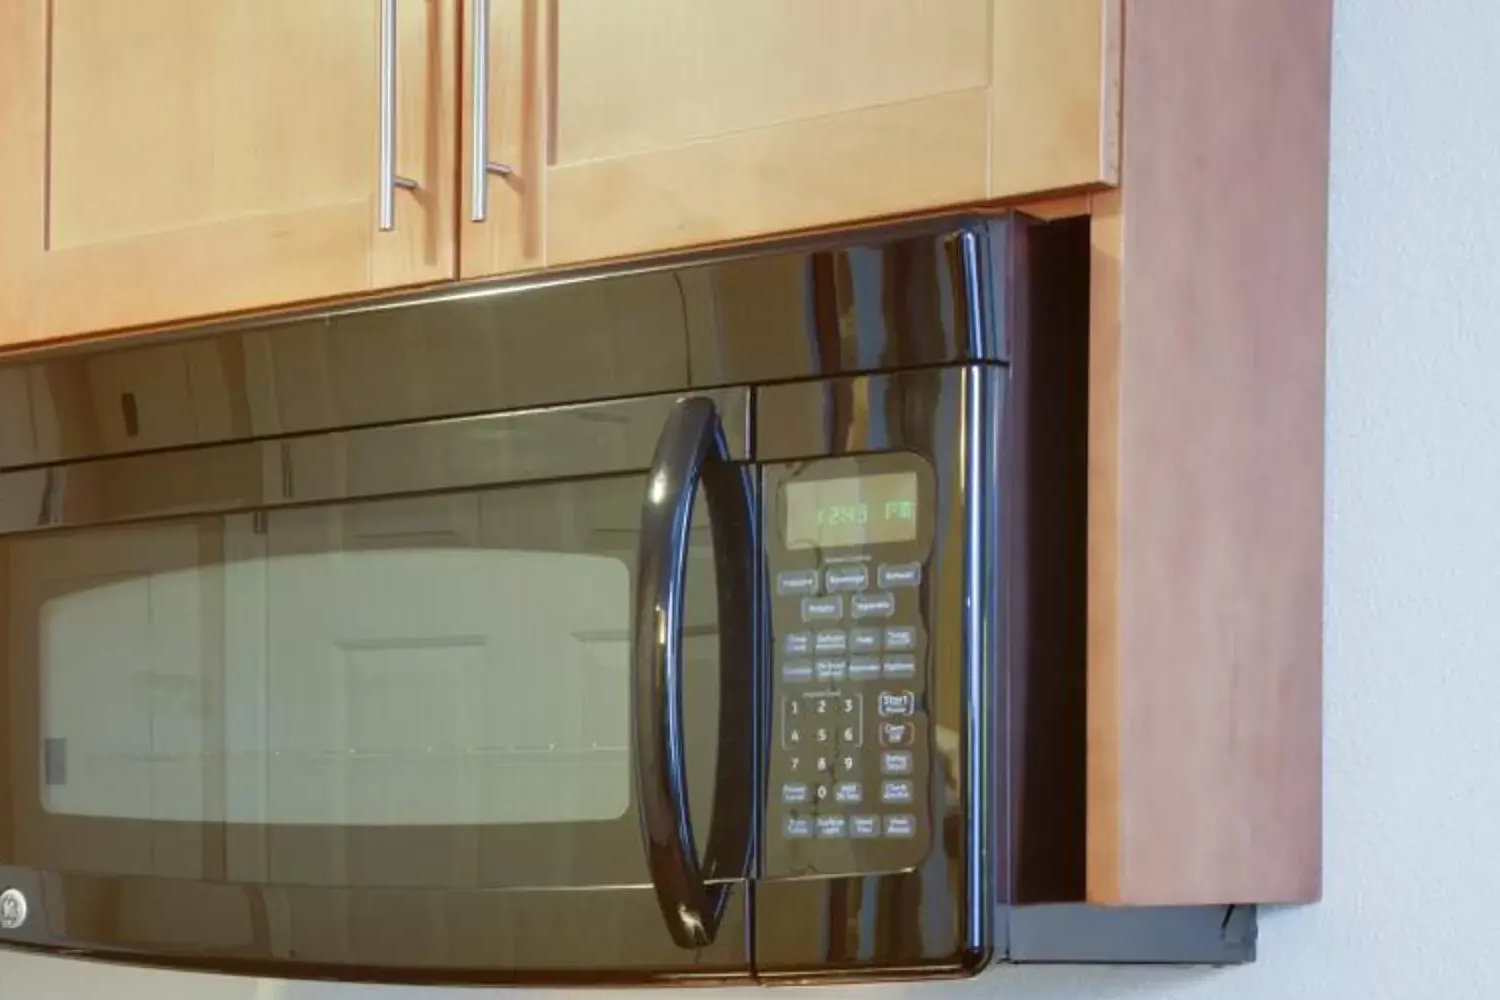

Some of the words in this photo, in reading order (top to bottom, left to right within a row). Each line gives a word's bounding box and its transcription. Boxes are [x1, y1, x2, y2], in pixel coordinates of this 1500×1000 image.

[791, 700, 799, 714] 1
[817, 700, 826, 713] 2
[844, 699, 853, 713] 3
[791, 729, 799, 741] 4
[817, 728, 827, 741] 5
[844, 727, 853, 741] 6
[791, 757, 799, 771] 7
[817, 756, 827, 770] 8
[844, 756, 853, 770] 9
[817, 785, 827, 799] 0
